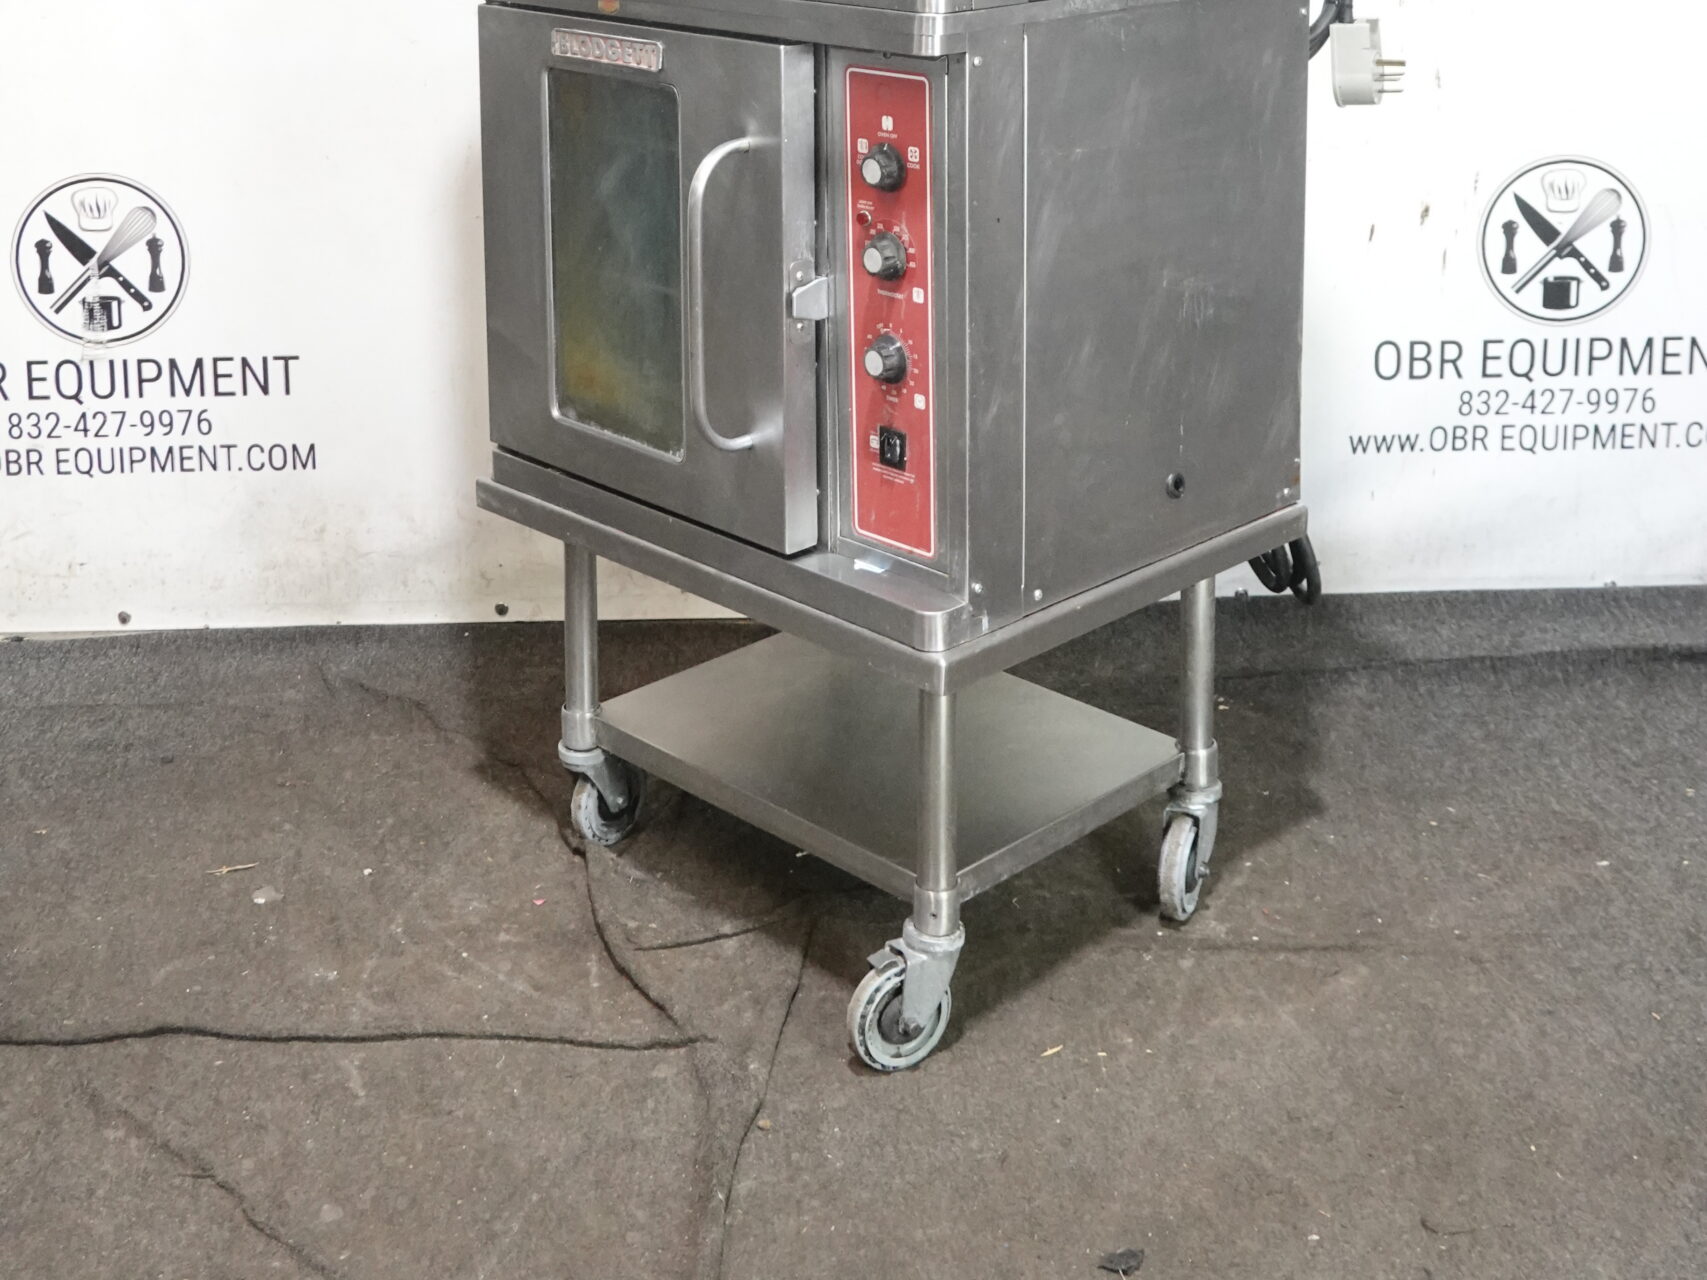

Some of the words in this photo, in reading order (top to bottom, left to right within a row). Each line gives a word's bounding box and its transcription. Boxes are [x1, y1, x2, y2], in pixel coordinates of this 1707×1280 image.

[559, 32, 657, 69] BLODGETT
[1375, 340, 1463, 380] OBR
[26, 355, 300, 405] EQUIPMENT
[1459, 388, 1655, 416] 832-427-9976
[8, 409, 212, 439] 832-427-9976
[1349, 425, 1488, 455] www.OBR
[1501, 422, 1707, 454] EQUIPMENT.C
[0, 448, 44, 476] BR
[56, 443, 316, 478] EQUIPMENT.COM
